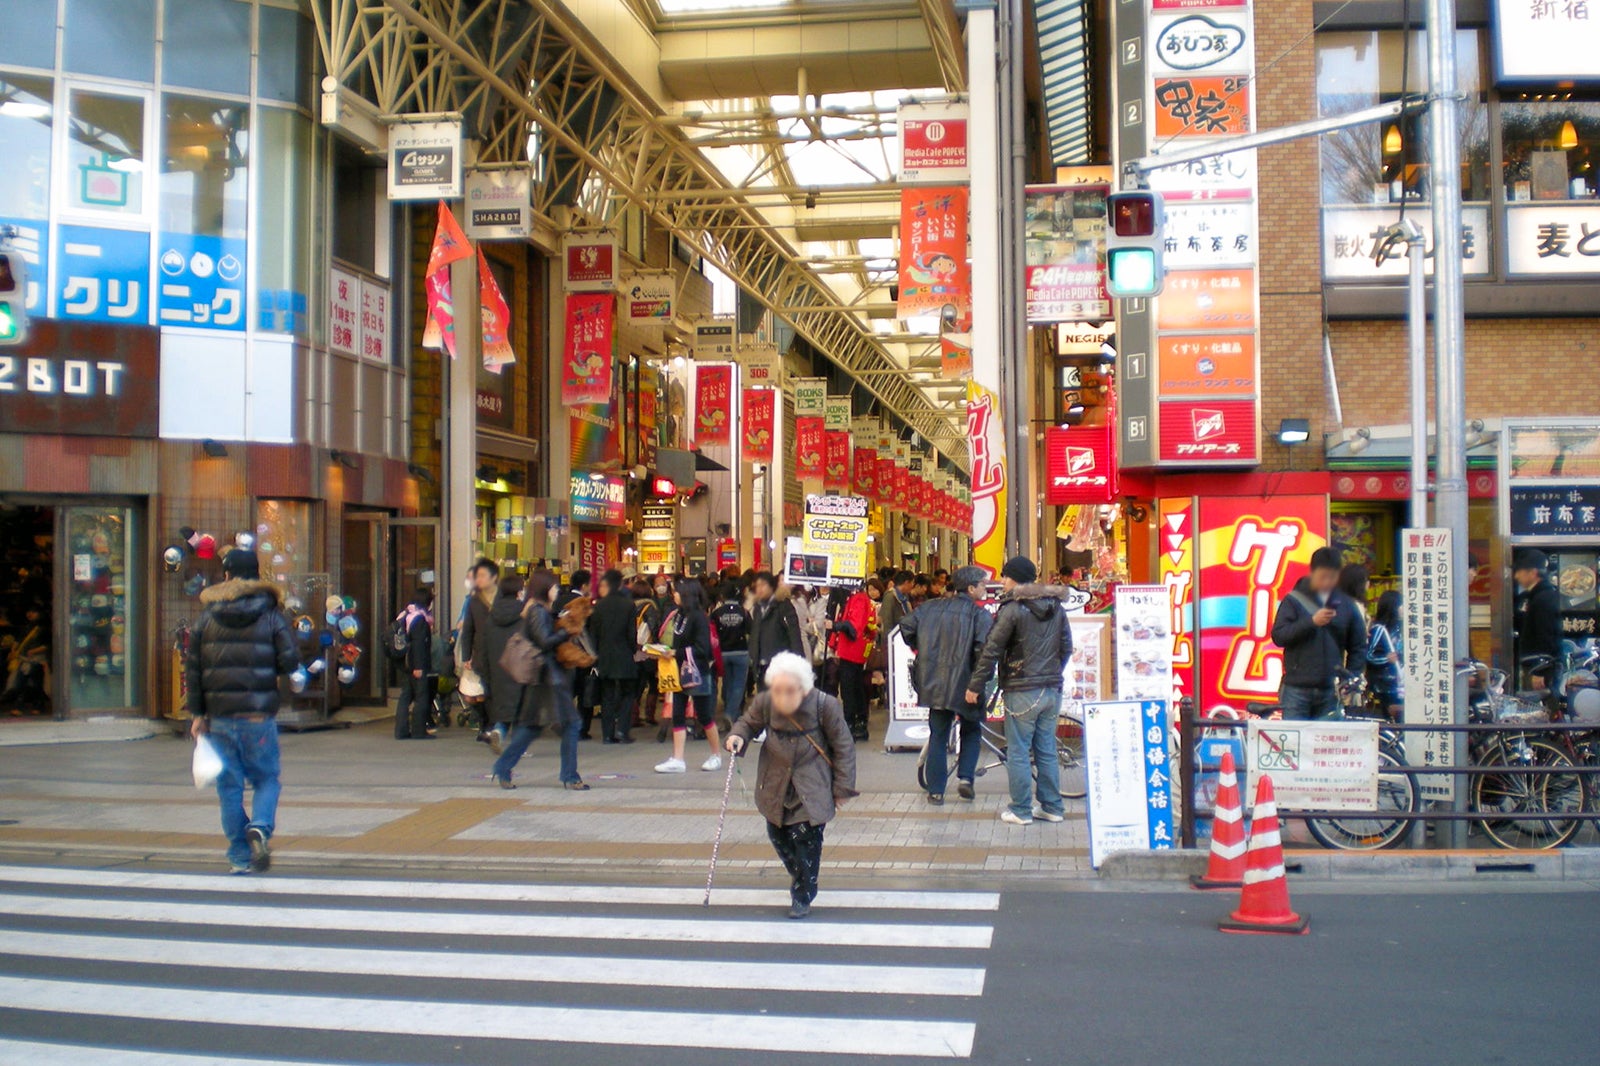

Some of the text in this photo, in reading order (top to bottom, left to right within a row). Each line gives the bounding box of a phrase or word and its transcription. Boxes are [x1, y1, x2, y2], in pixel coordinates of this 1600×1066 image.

[1127, 44, 1136, 60] 2
[1167, 34, 1228, 54] おひつ家
[1223, 78, 1248, 92] 2F
[1128, 105, 1137, 121] 2
[1155, 80, 1231, 132] 串家
[402, 151, 445, 167] ムサシノ
[1181, 156, 1247, 179] ねぎし
[1191, 189, 1218, 200] 2F
[911, 221, 922, 260] サンロード
[338, 279, 348, 301] 夜
[1170, 277, 1241, 288] くすり・化粧品
[362, 311, 385, 333] 祝日も
[333, 323, 352, 349] 診療
[1066, 334, 1110, 344] NEGIS
[364, 334, 383, 359] 診療
[1171, 343, 1243, 354] くすり・化粧品
[1133, 359, 1140, 374] 1
[797, 388, 824, 397] BOOKS
[1130, 422, 1144, 436] B1
[1226, 522, 1300, 694] ゲーム
[1144, 702, 1169, 809] 中国語会話
